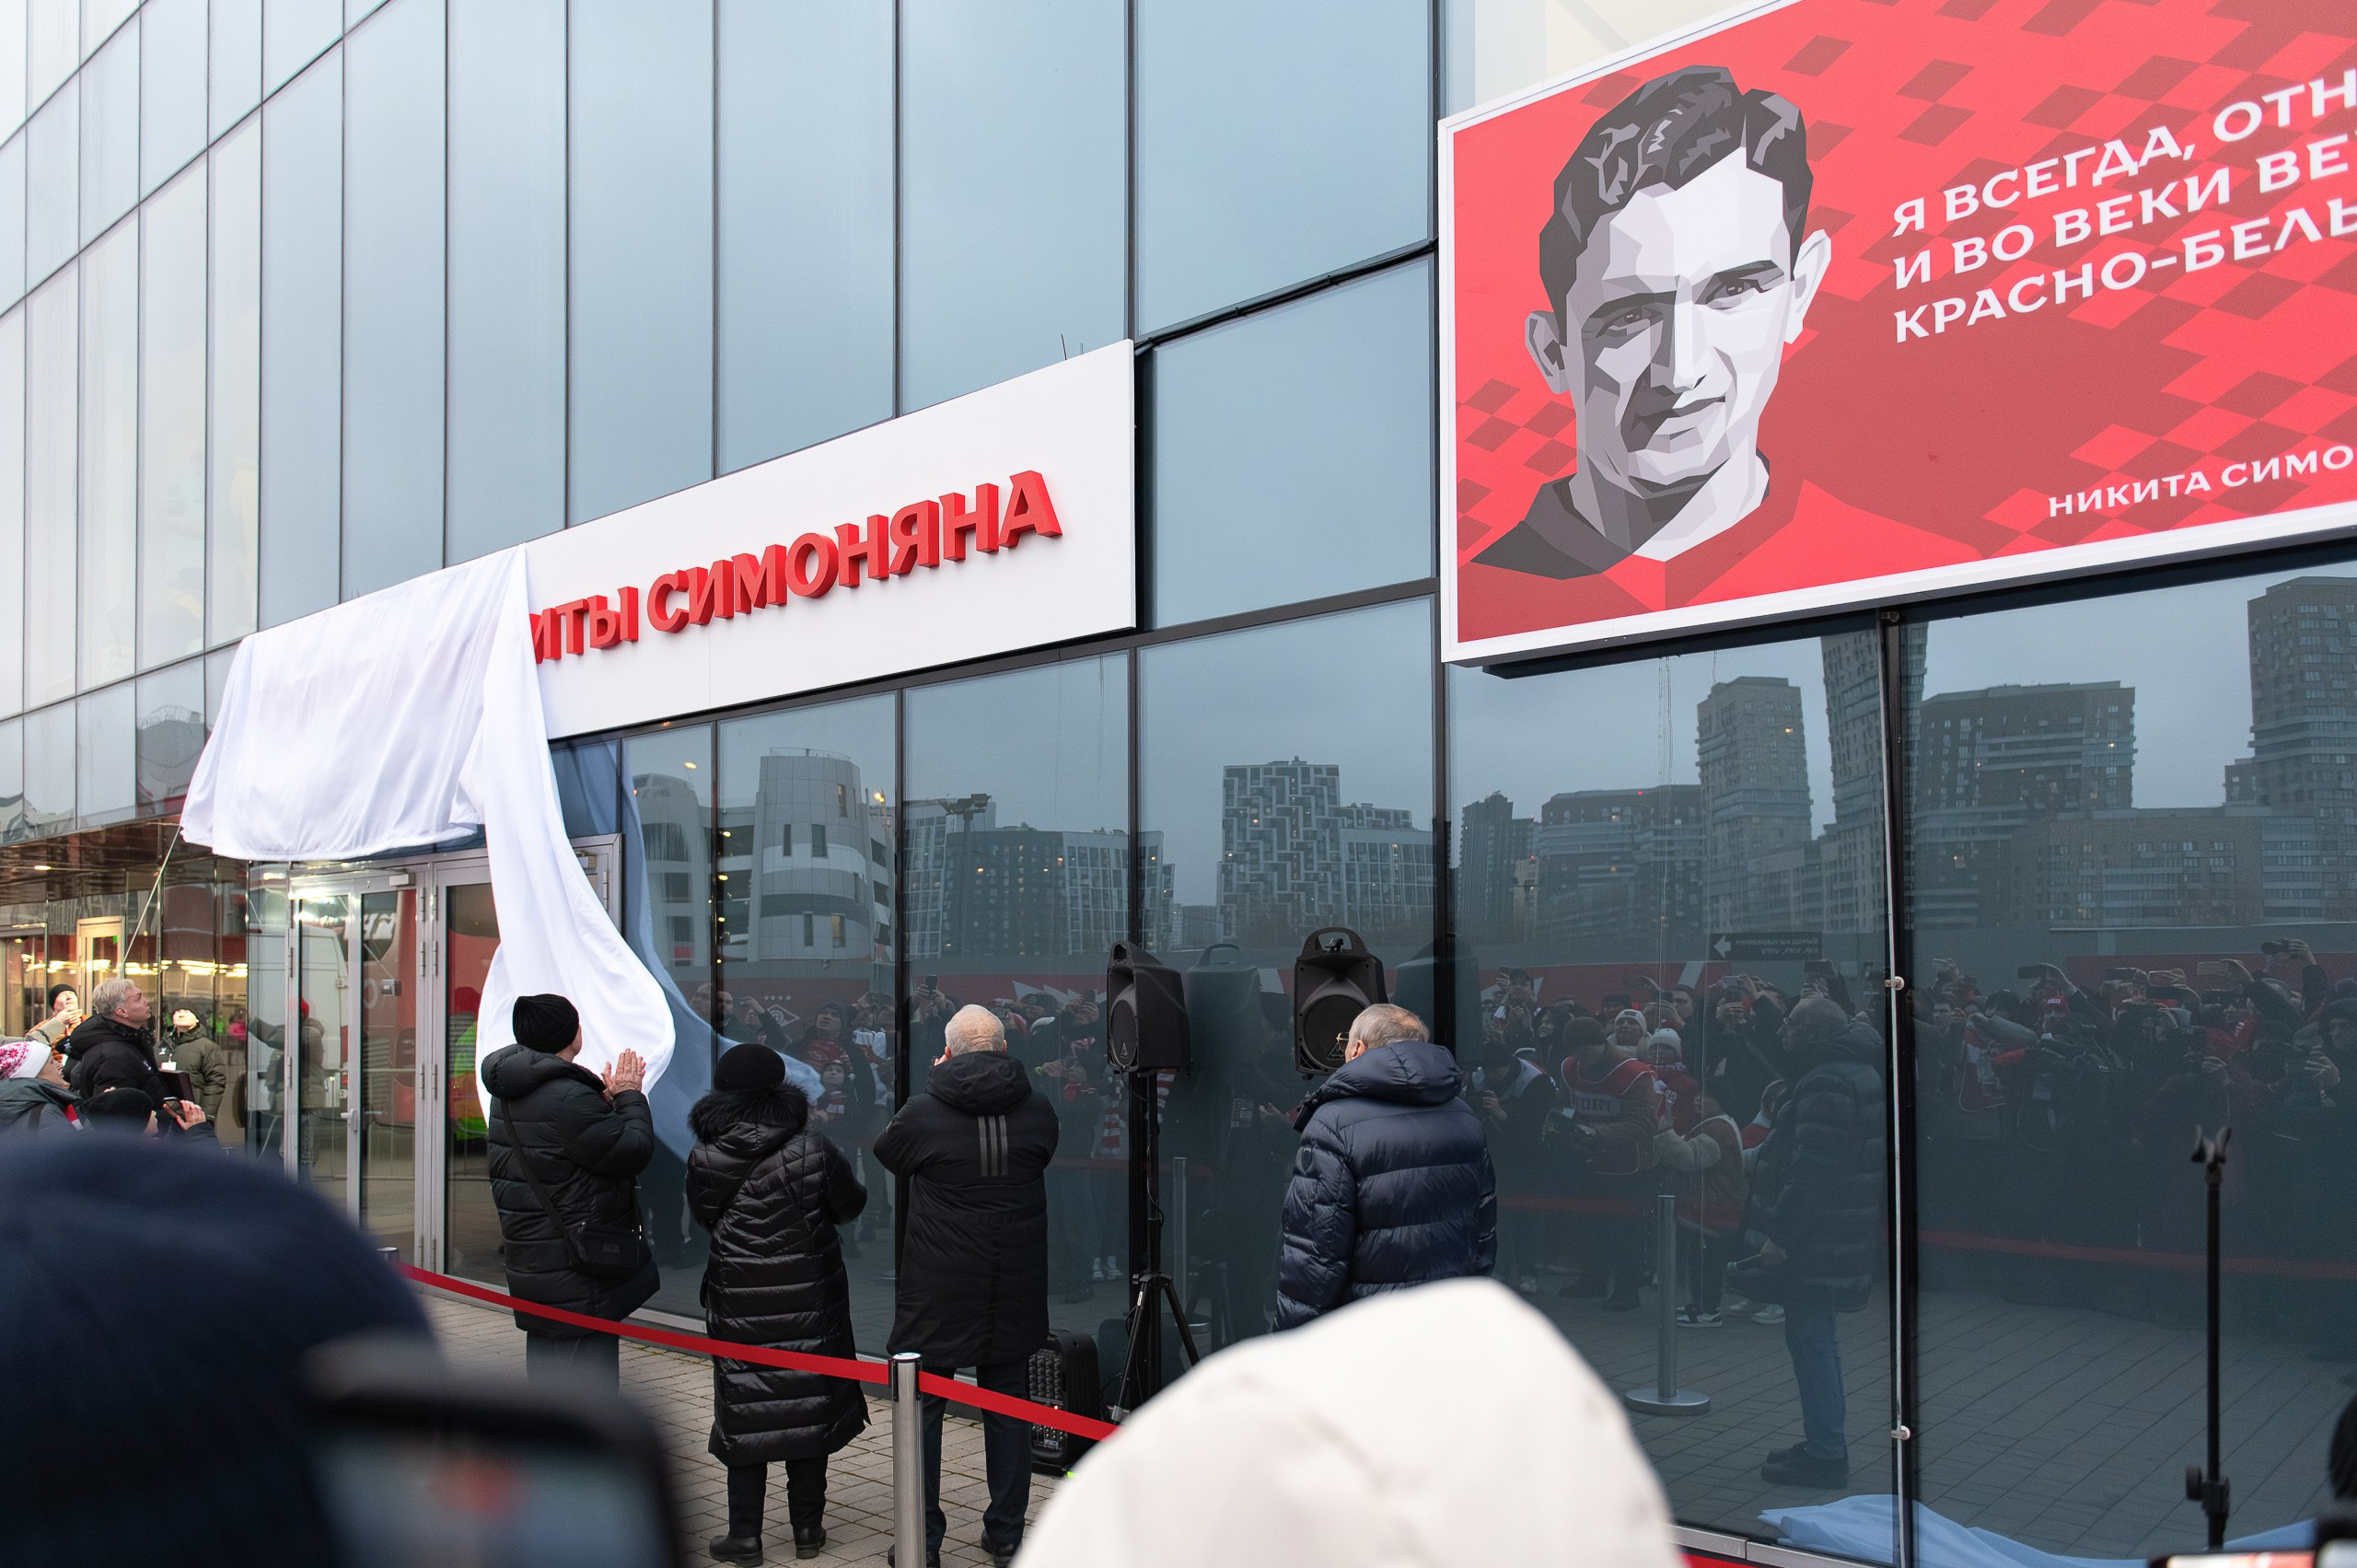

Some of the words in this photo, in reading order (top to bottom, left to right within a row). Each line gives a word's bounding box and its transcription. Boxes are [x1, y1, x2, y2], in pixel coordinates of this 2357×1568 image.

[1891, 197, 1925, 237] Я
[1943, 124, 2195, 222] ВСЕГДА,
[2212, 68, 2357, 142] ОТН
[1892, 256, 1931, 290] И
[1951, 224, 2035, 273] ВО
[2052, 168, 2230, 247] ВЕКИ
[2255, 129, 2357, 193] ВЕ
[646, 470, 1063, 633] СИМОНЯНА
[2048, 470, 2212, 517] НИКИТА
[2221, 446, 2354, 488] СИМО
